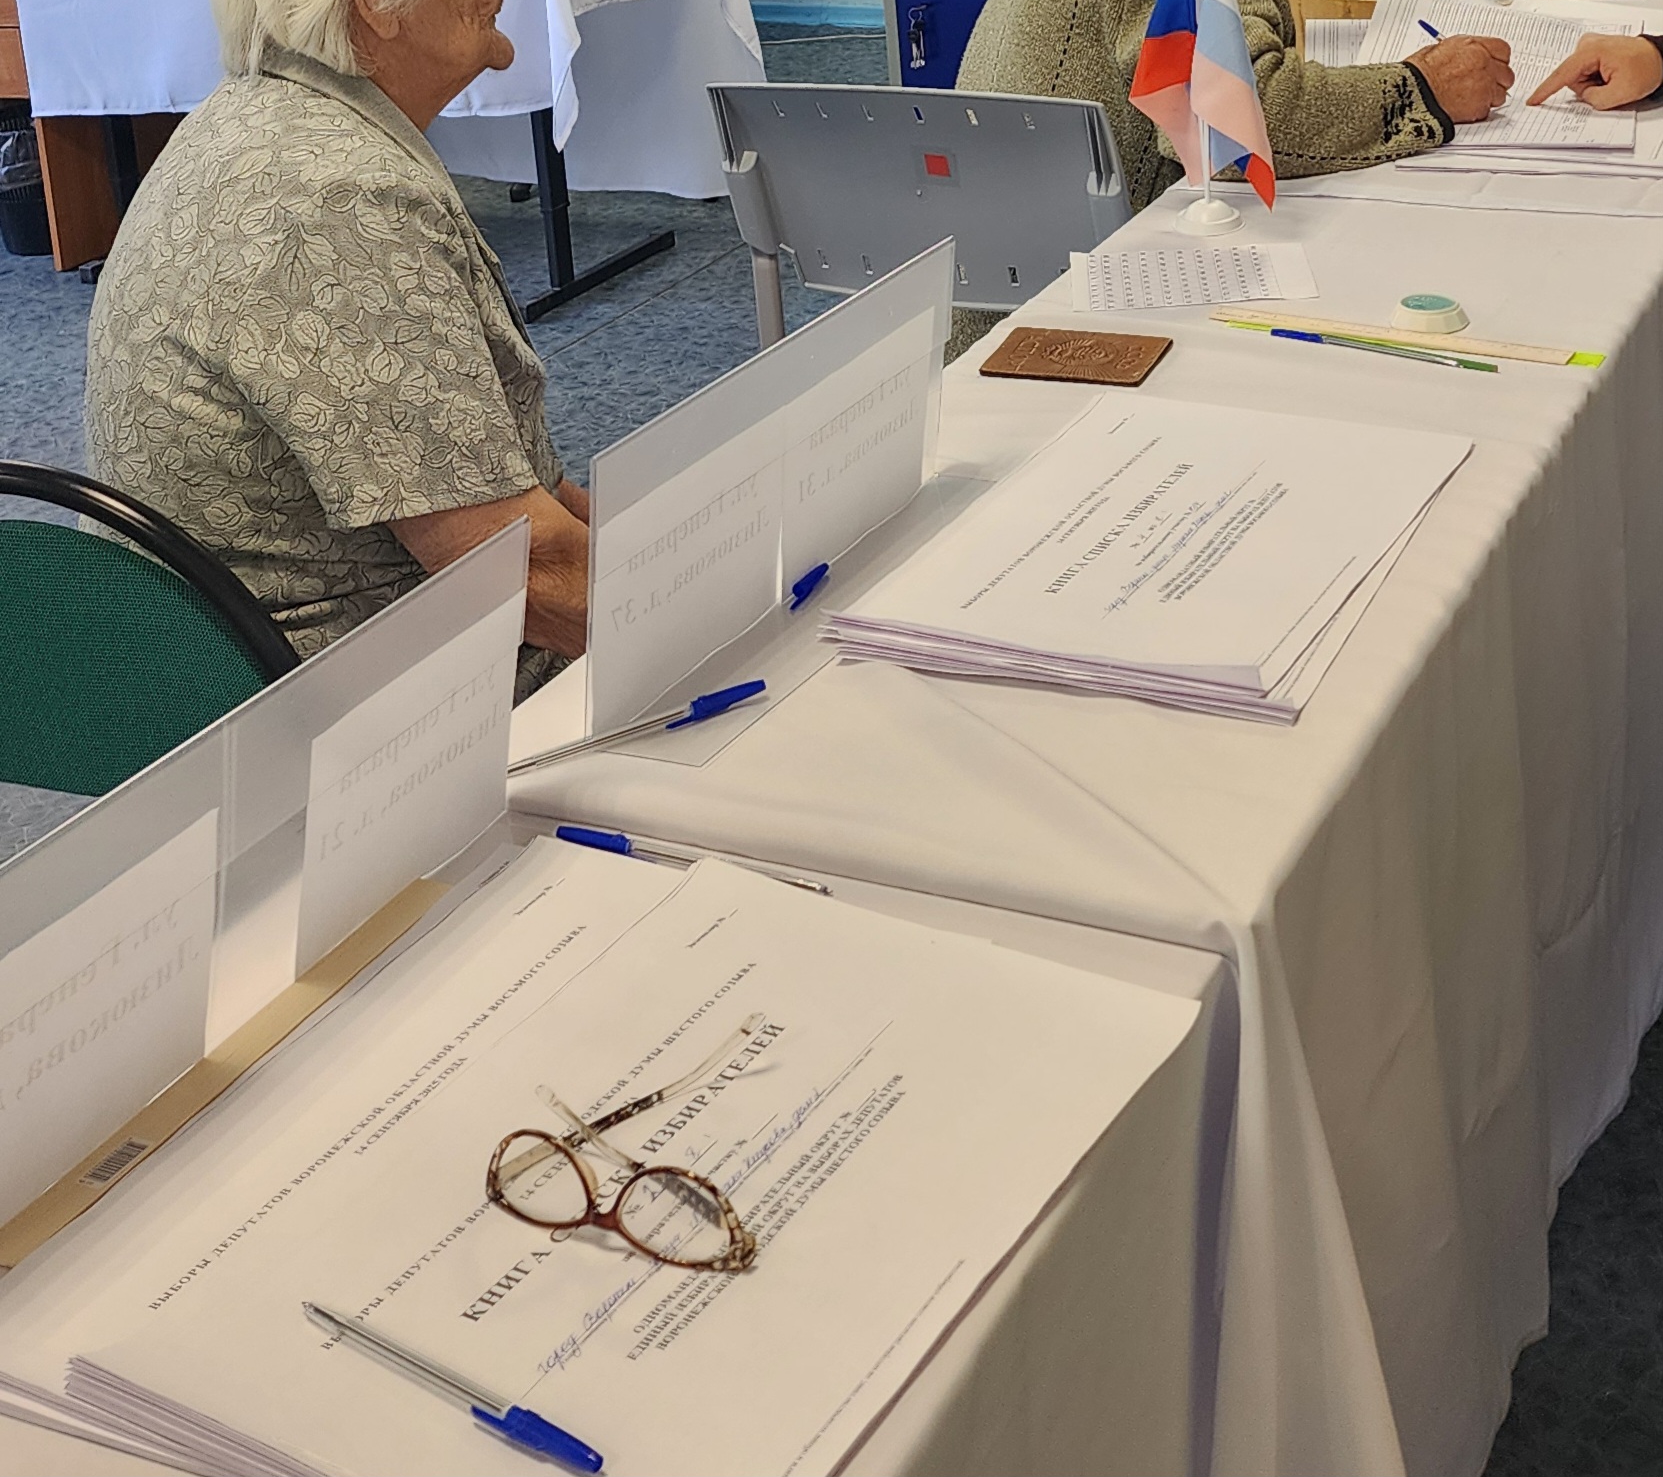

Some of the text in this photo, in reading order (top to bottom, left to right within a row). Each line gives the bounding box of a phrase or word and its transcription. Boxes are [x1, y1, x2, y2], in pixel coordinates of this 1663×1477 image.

[1042, 561, 1089, 593] КНИГА
[1079, 522, 1131, 561] СПИСКА
[1121, 462, 1194, 520] ИЗБИРАТЕЛЕЙ
[147, 923, 588, 1310] ВЫБОРЫ ДЕПУТАТОВ ВОРОНЕЖСКОЙ ОБЛАСТНОЙ ДУМЫ ВОСЬМОГО СОЗЫВА
[381, 1226, 466, 1295] ДЕПУТАТОВ
[625, 1047, 665, 1078] ДУМЫ
[660, 1000, 716, 1045] ШЕСТОГО
[712, 961, 758, 998] СОЗЫВА
[458, 1246, 553, 1322] КНИГА
[638, 1021, 787, 1153] ИЗБИРАТЕЛЕЙ
[625, 1311, 678, 1360] ЕДИНЫЙ
[759, 1190, 797, 1222] ОКРУГ
[791, 1174, 811, 1188] НА
[805, 1128, 854, 1173] ВЫБОРАХ
[849, 1073, 905, 1127] ДЕПУТАТОВ
[733, 1154, 814, 1228] БИРАТЕЛЬНЫЙ
[808, 1121, 844, 1153] ОКРУГ
[793, 1173, 831, 1207] ДУМЫ
[821, 1128, 873, 1175] ШЕСТОГО
[864, 1090, 907, 1128] СОЗЫВА
